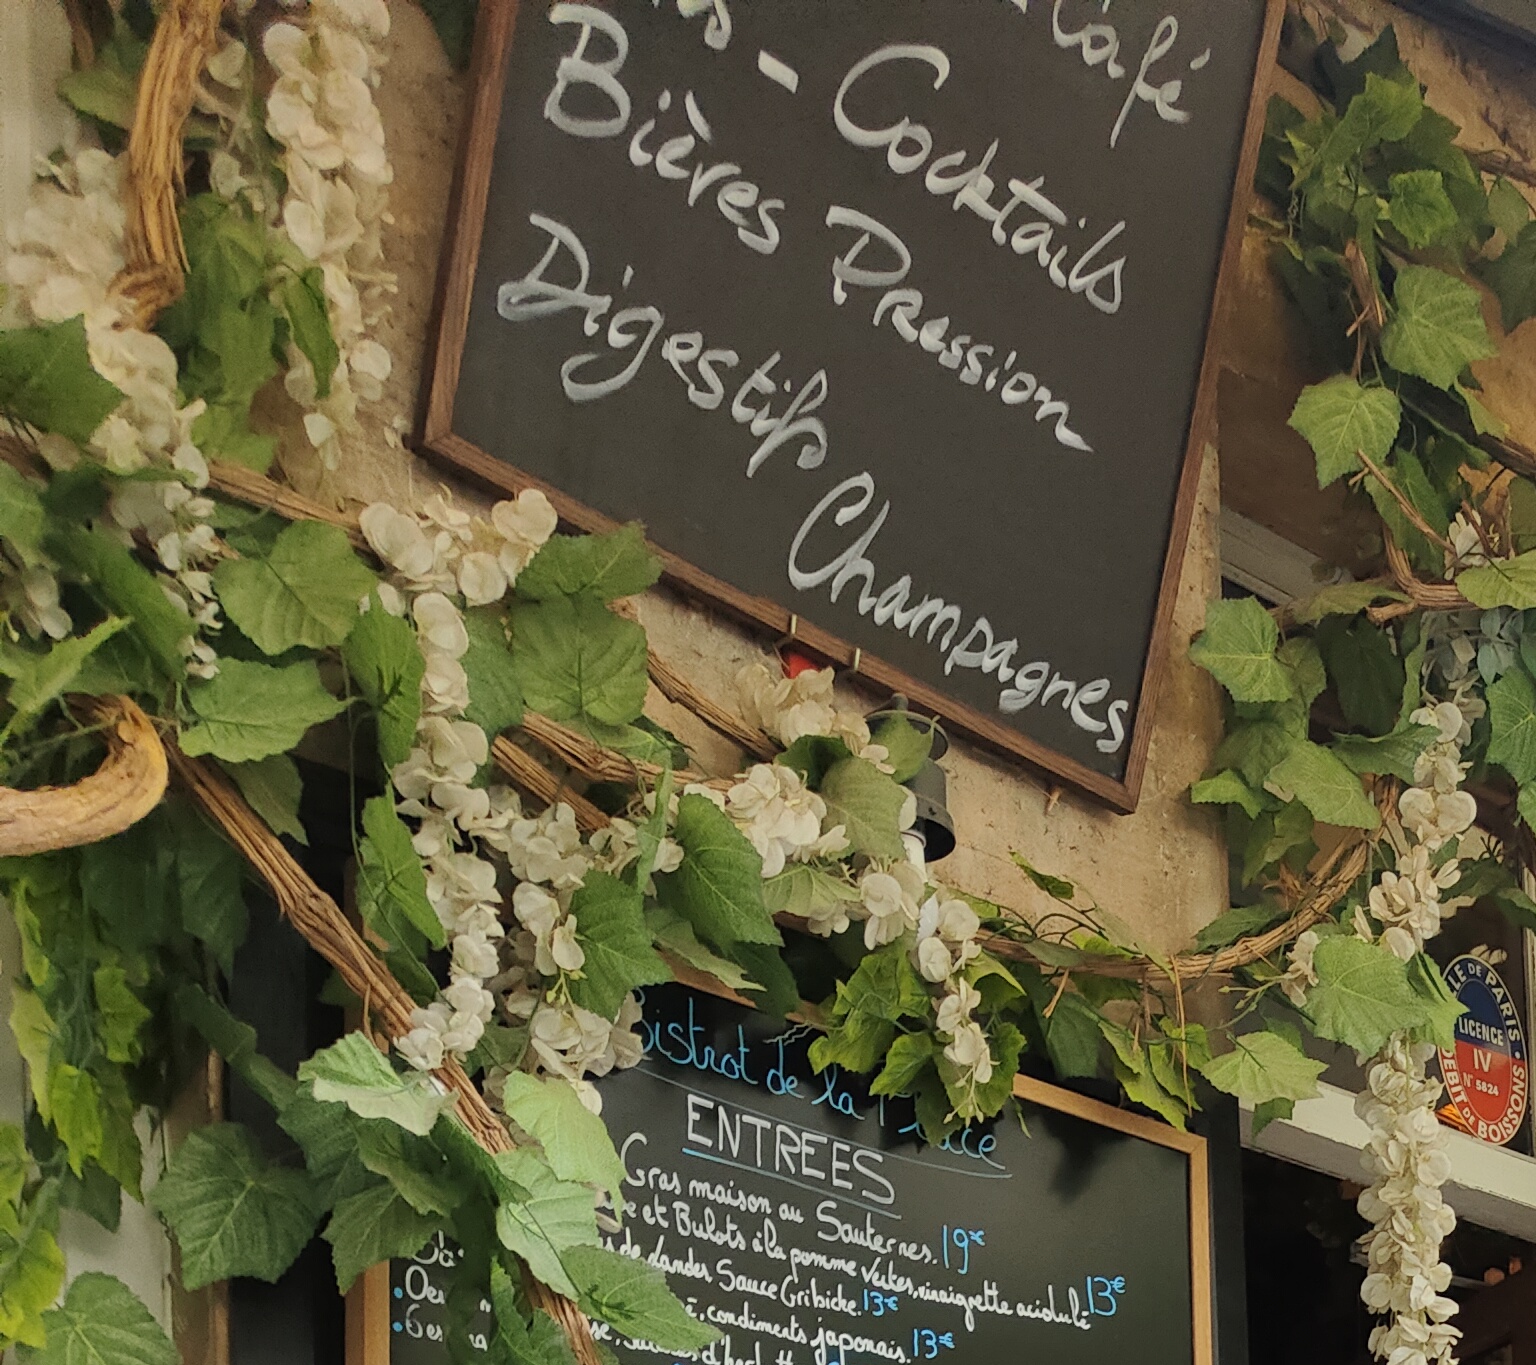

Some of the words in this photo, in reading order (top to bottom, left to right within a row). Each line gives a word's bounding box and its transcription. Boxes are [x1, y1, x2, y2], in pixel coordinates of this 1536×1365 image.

[543, 4, 786, 255] Bières
[825, 205, 1095, 451] Pression
[497, 213, 828, 478] Digestifs
[788, 471, 1128, 754] Champagnes
[1459, 1017, 1503, 1046] LICENCE
[1468, 963, 1481, 976] DE
[1485, 971, 1520, 1041] PARIS
[767, 1037, 805, 1098] de
[811, 1064, 865, 1120] la
[1473, 1048, 1491, 1072] IV
[1475, 1079, 1499, 1096] 5824
[1462, 1107, 1475, 1126] DE
[1477, 1064, 1525, 1143] BOISSONS
[686, 1094, 895, 1205] ENTREES
[642, 1194, 668, 1228] et
[672, 1202, 746, 1250] Bulots
[1087, 1275, 1125, 1316] 13€
[689, 1180, 772, 1214] maison
[779, 1203, 803, 1223] au
[942, 1224, 985, 1274] 19€
[716, 1259, 778, 1299] Sauce
[863, 1288, 899, 1316] 13€
[707, 1301, 808, 1344] condiments
[913, 1328, 955, 1359] 13€
